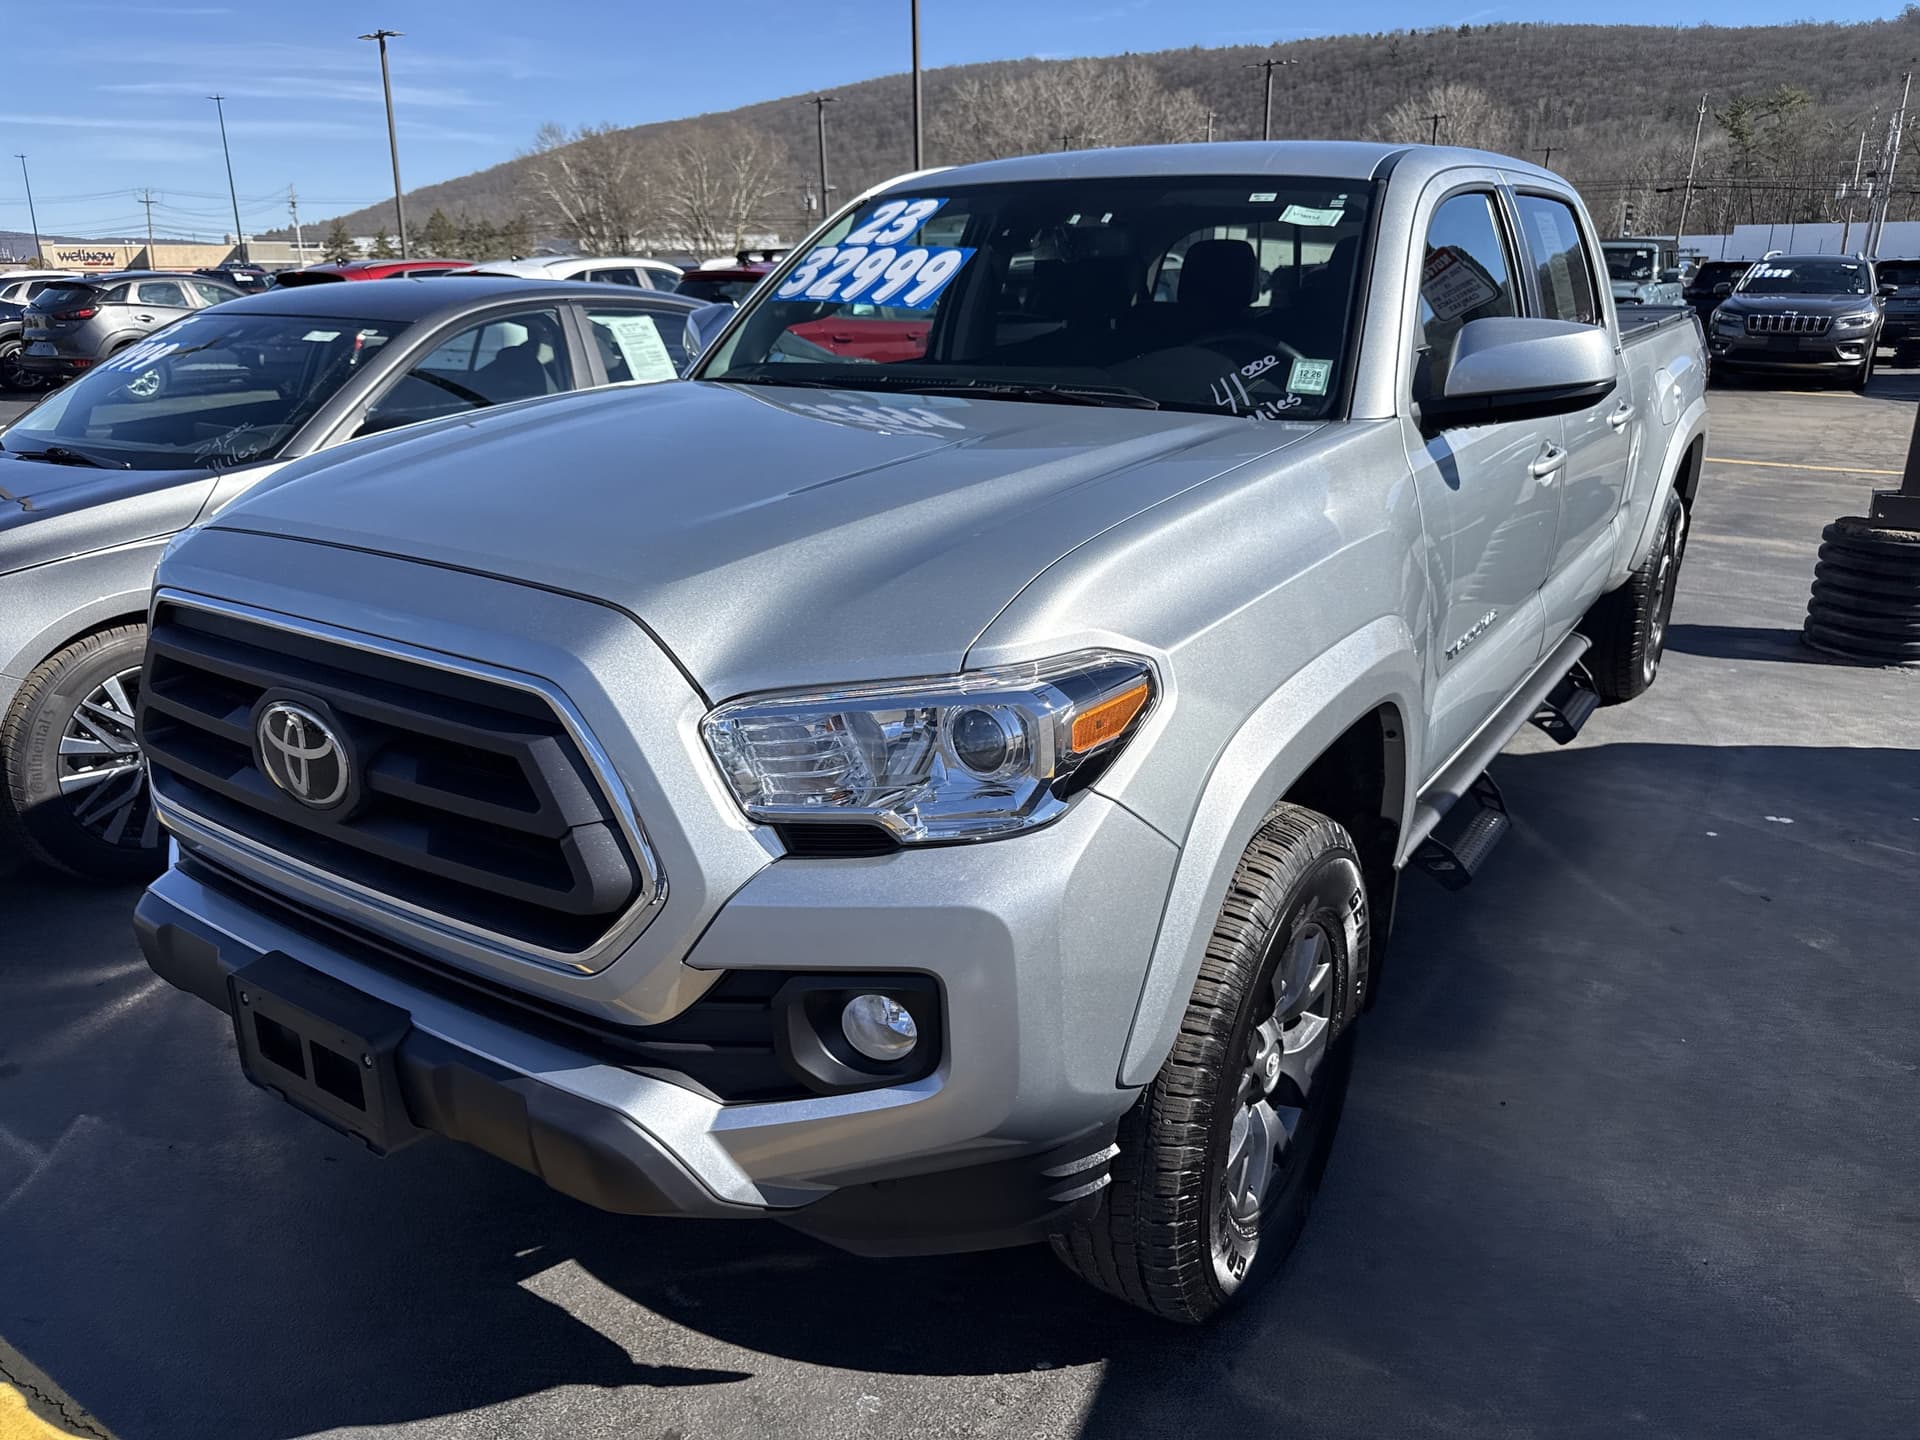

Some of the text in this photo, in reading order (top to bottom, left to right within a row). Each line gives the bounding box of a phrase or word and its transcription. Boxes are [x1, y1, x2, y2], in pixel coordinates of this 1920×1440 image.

[845, 199, 939, 245] 23
[778, 246, 962, 307] 32999
[1310, 370, 1322, 378] 26
